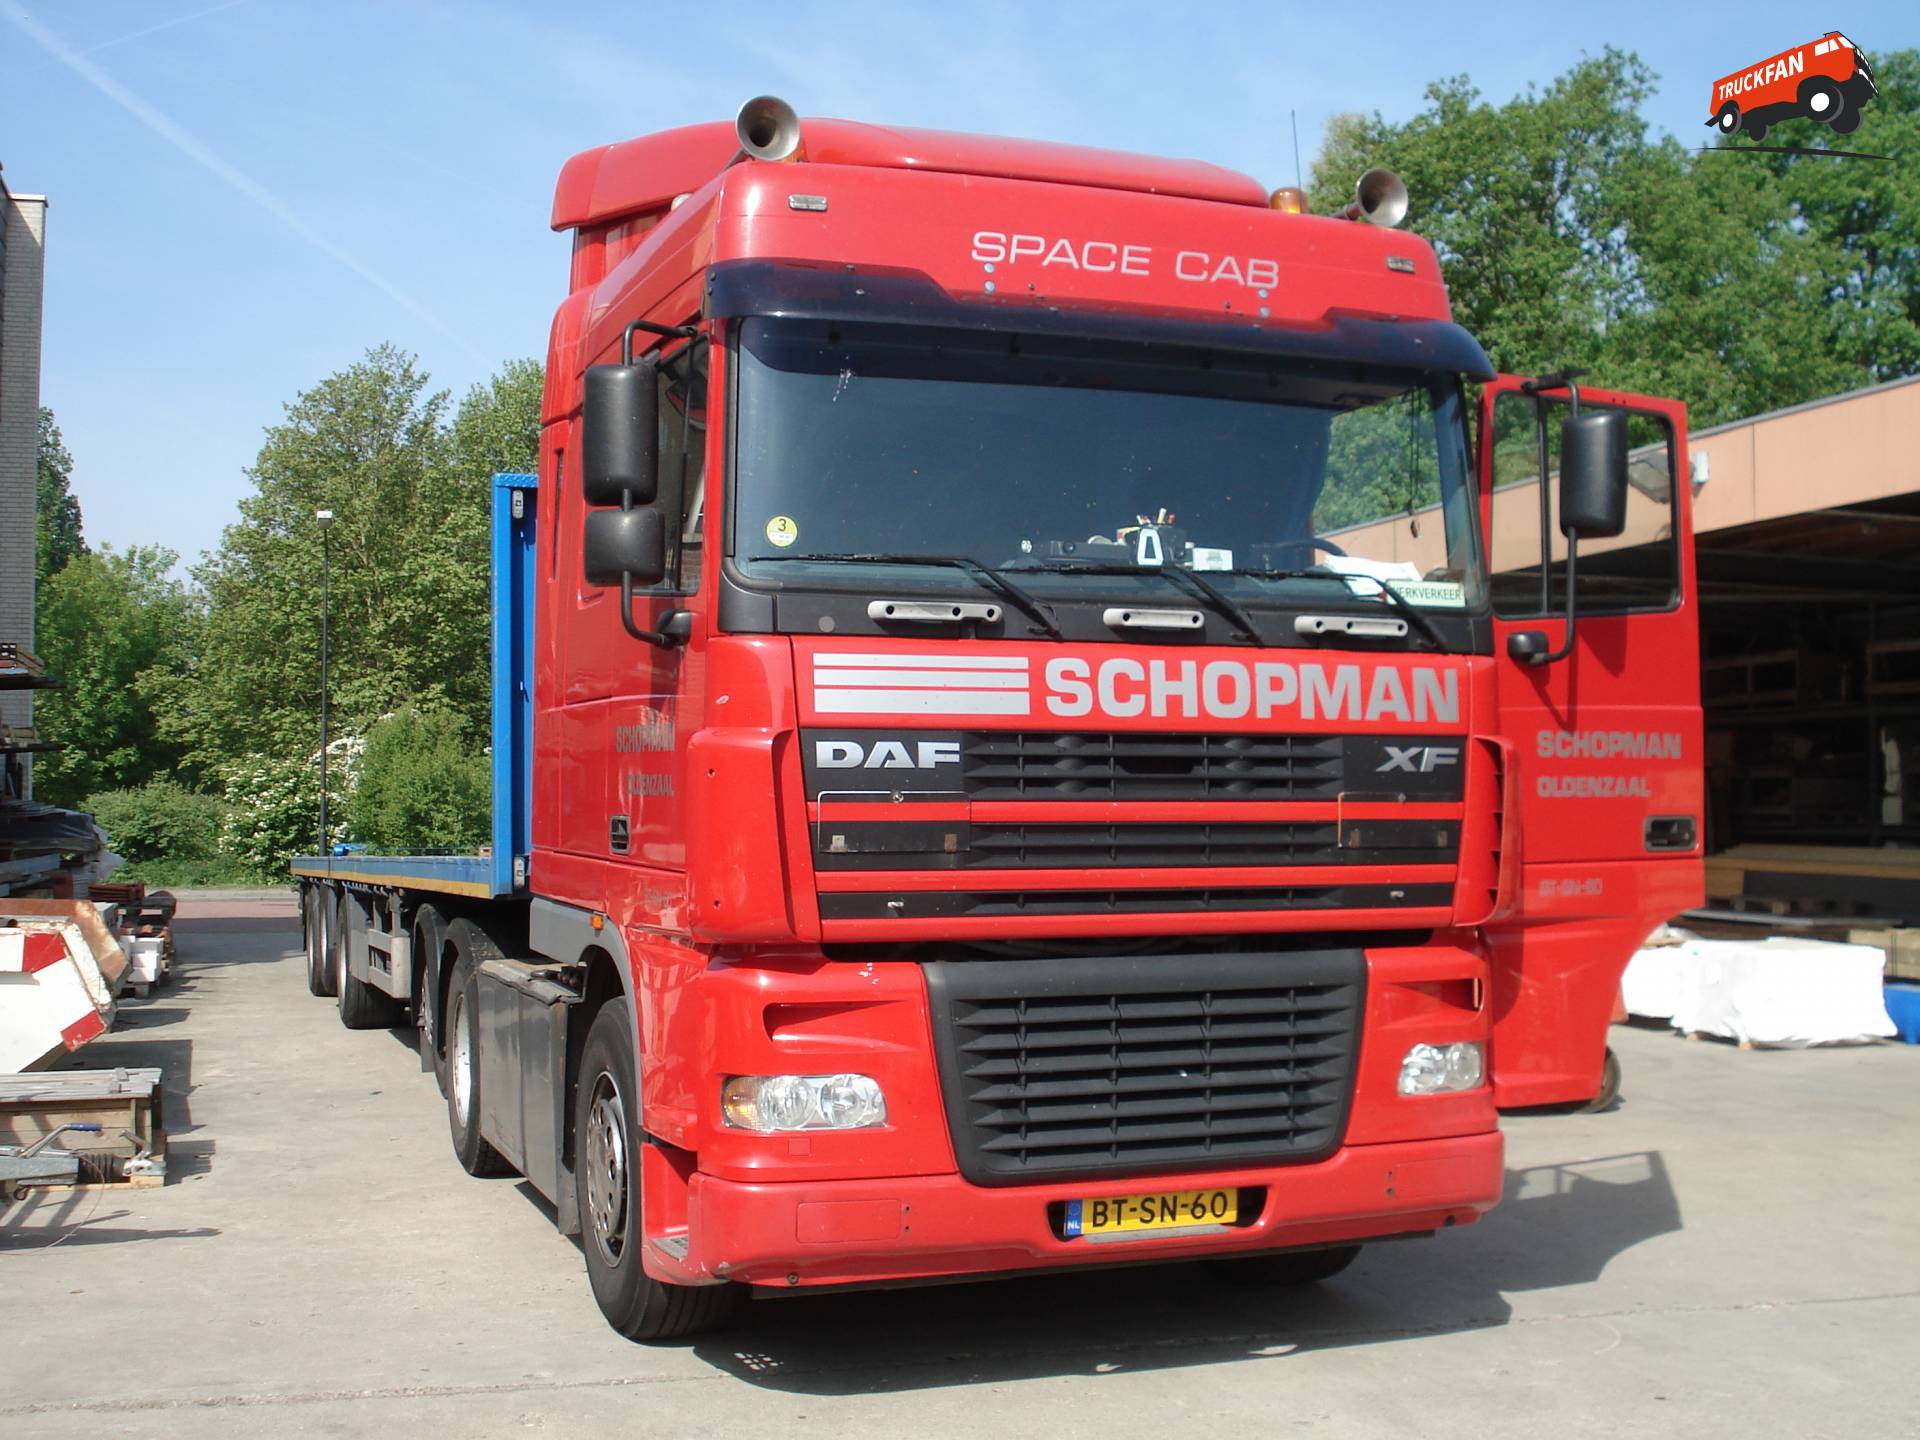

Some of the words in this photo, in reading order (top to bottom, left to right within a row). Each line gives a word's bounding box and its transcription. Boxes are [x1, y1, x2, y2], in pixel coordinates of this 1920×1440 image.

[971, 231, 1152, 276] SPACE
[1175, 251, 1279, 289] CAB
[777, 518, 787, 532] 3
[1045, 657, 1460, 723] SCHOPMAN
[815, 740, 961, 769] DAF
[1537, 730, 1682, 759] SCHOPMAN
[1376, 746, 1459, 773] XF
[1537, 775, 1652, 798] OLDENZAAL
[1092, 1191, 1228, 1228] BT-SN-60
